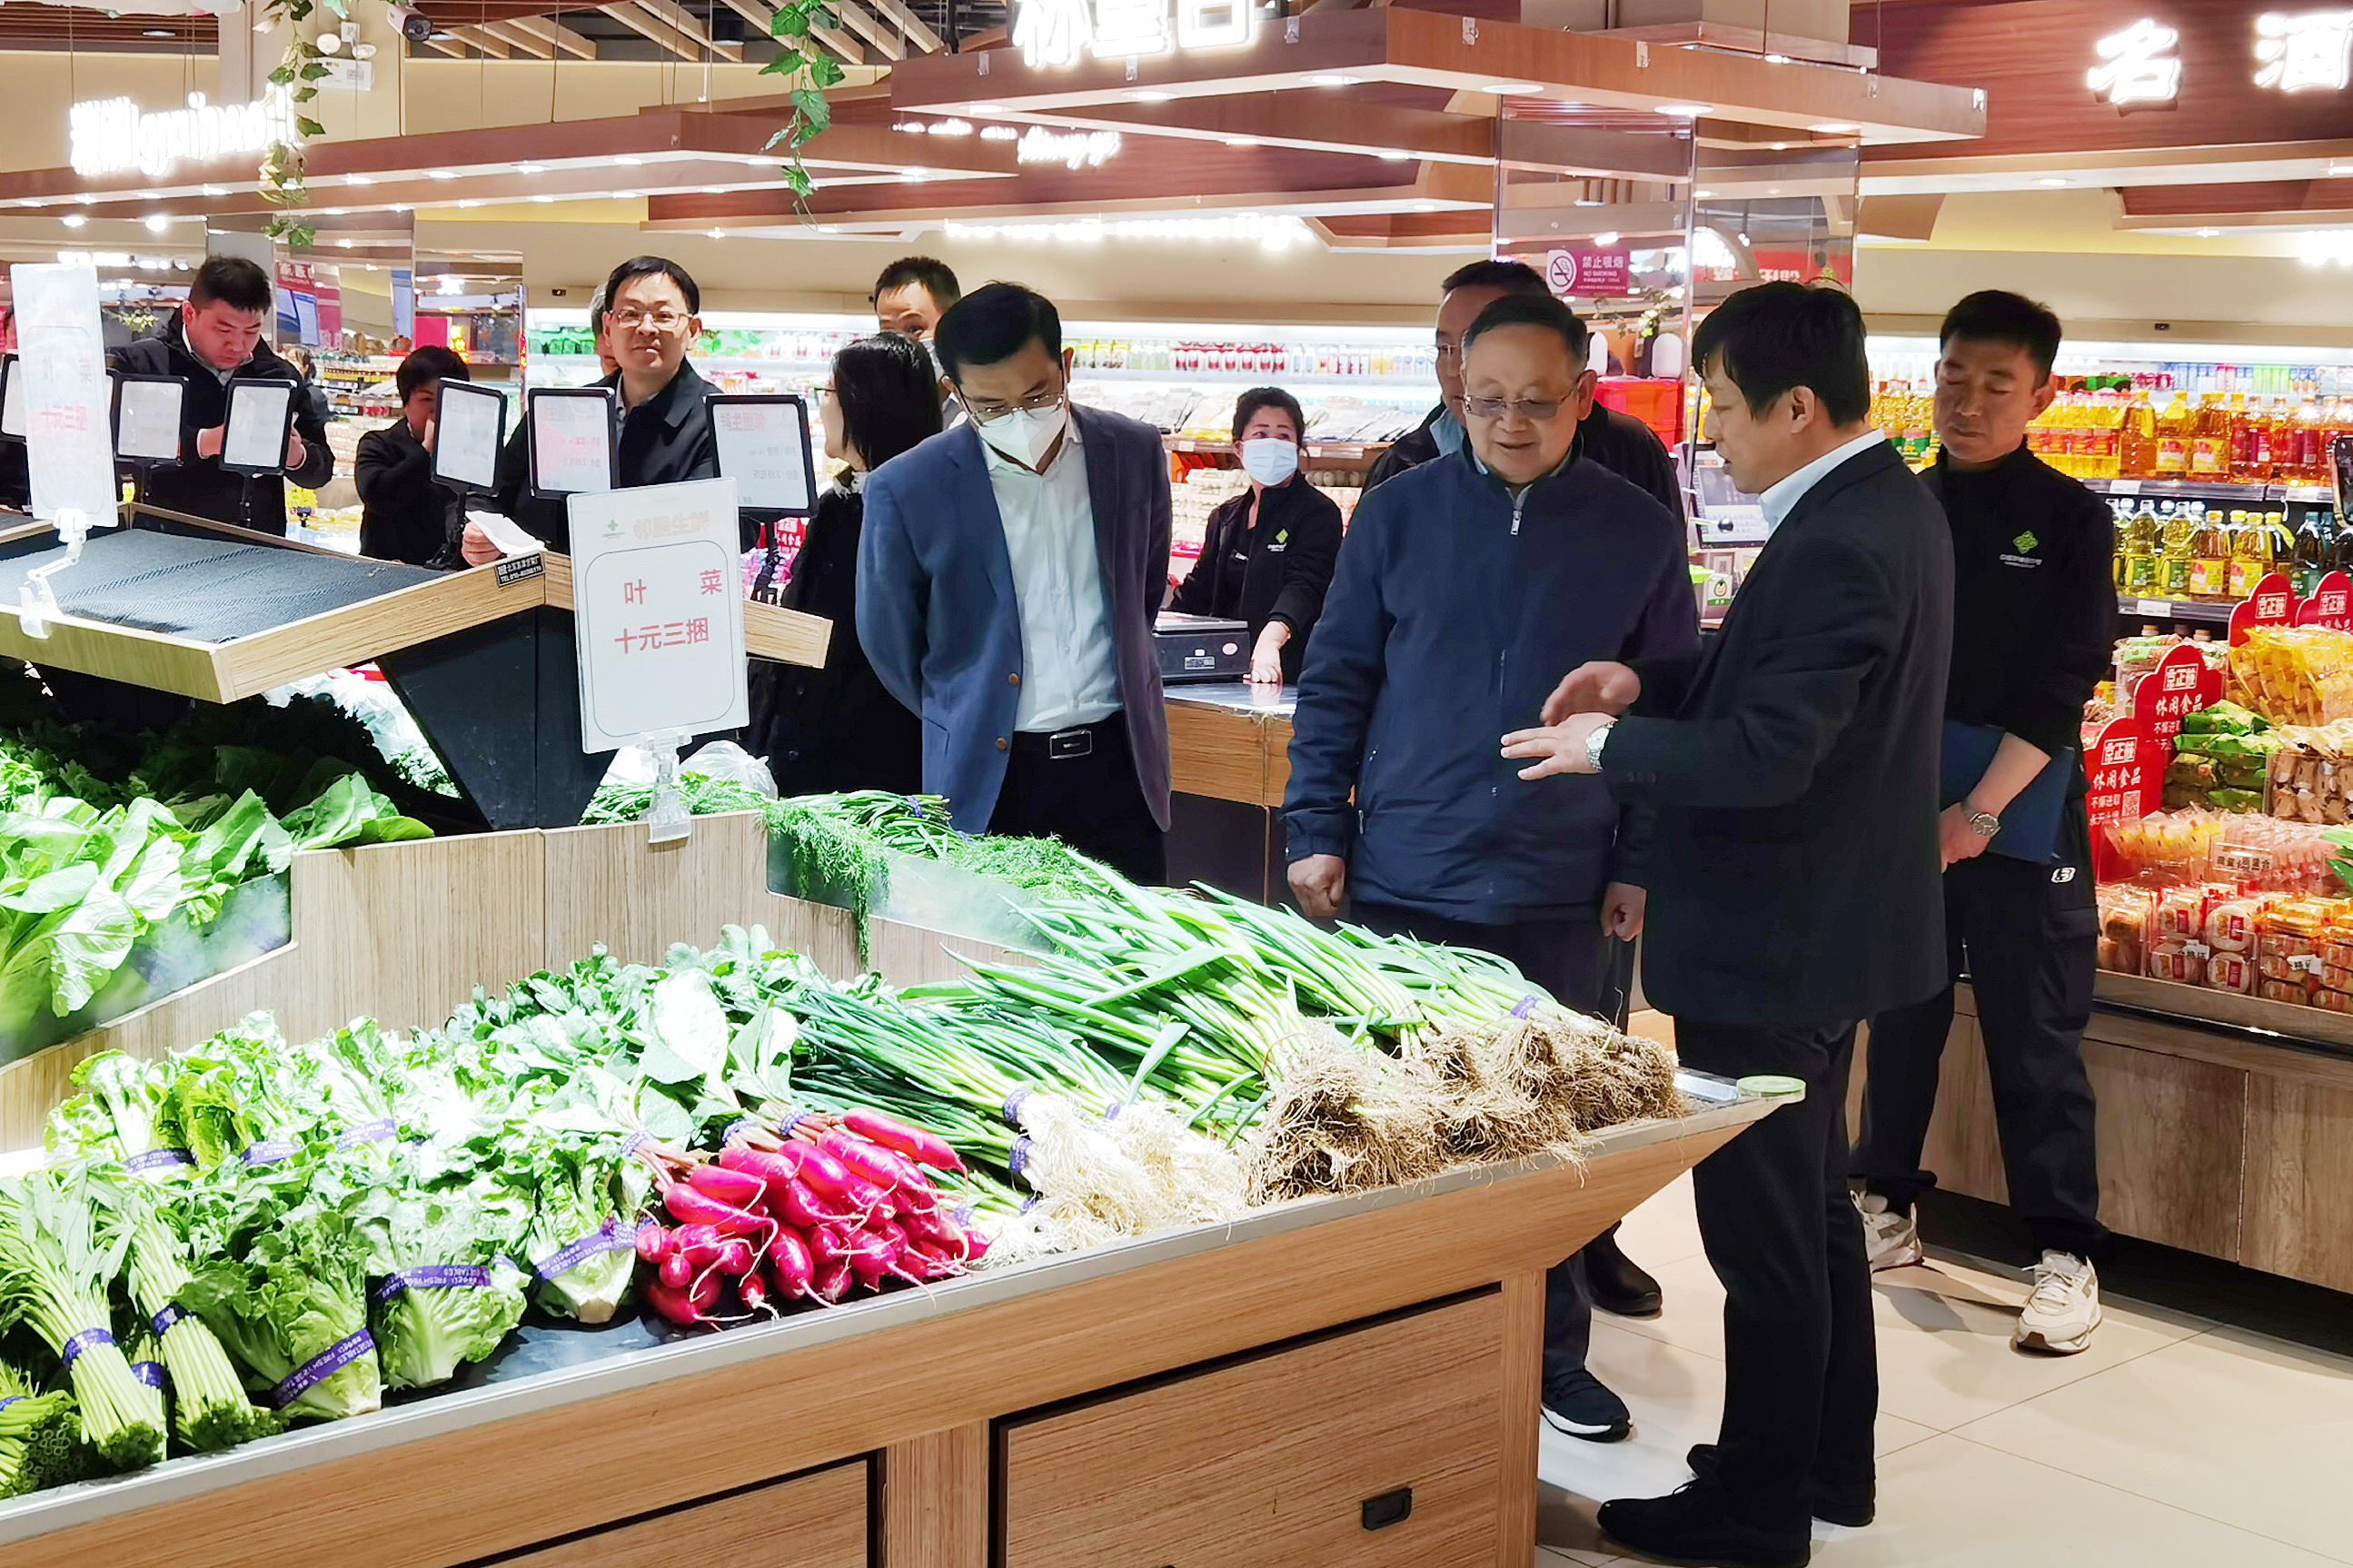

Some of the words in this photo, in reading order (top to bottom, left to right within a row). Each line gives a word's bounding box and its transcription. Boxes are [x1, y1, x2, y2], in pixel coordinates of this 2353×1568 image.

[1582, 255, 1623, 269] 禁止吸烟
[624, 579, 647, 605] 叶
[699, 569, 723, 596] 菜
[614, 617, 710, 655] 十元三捆
